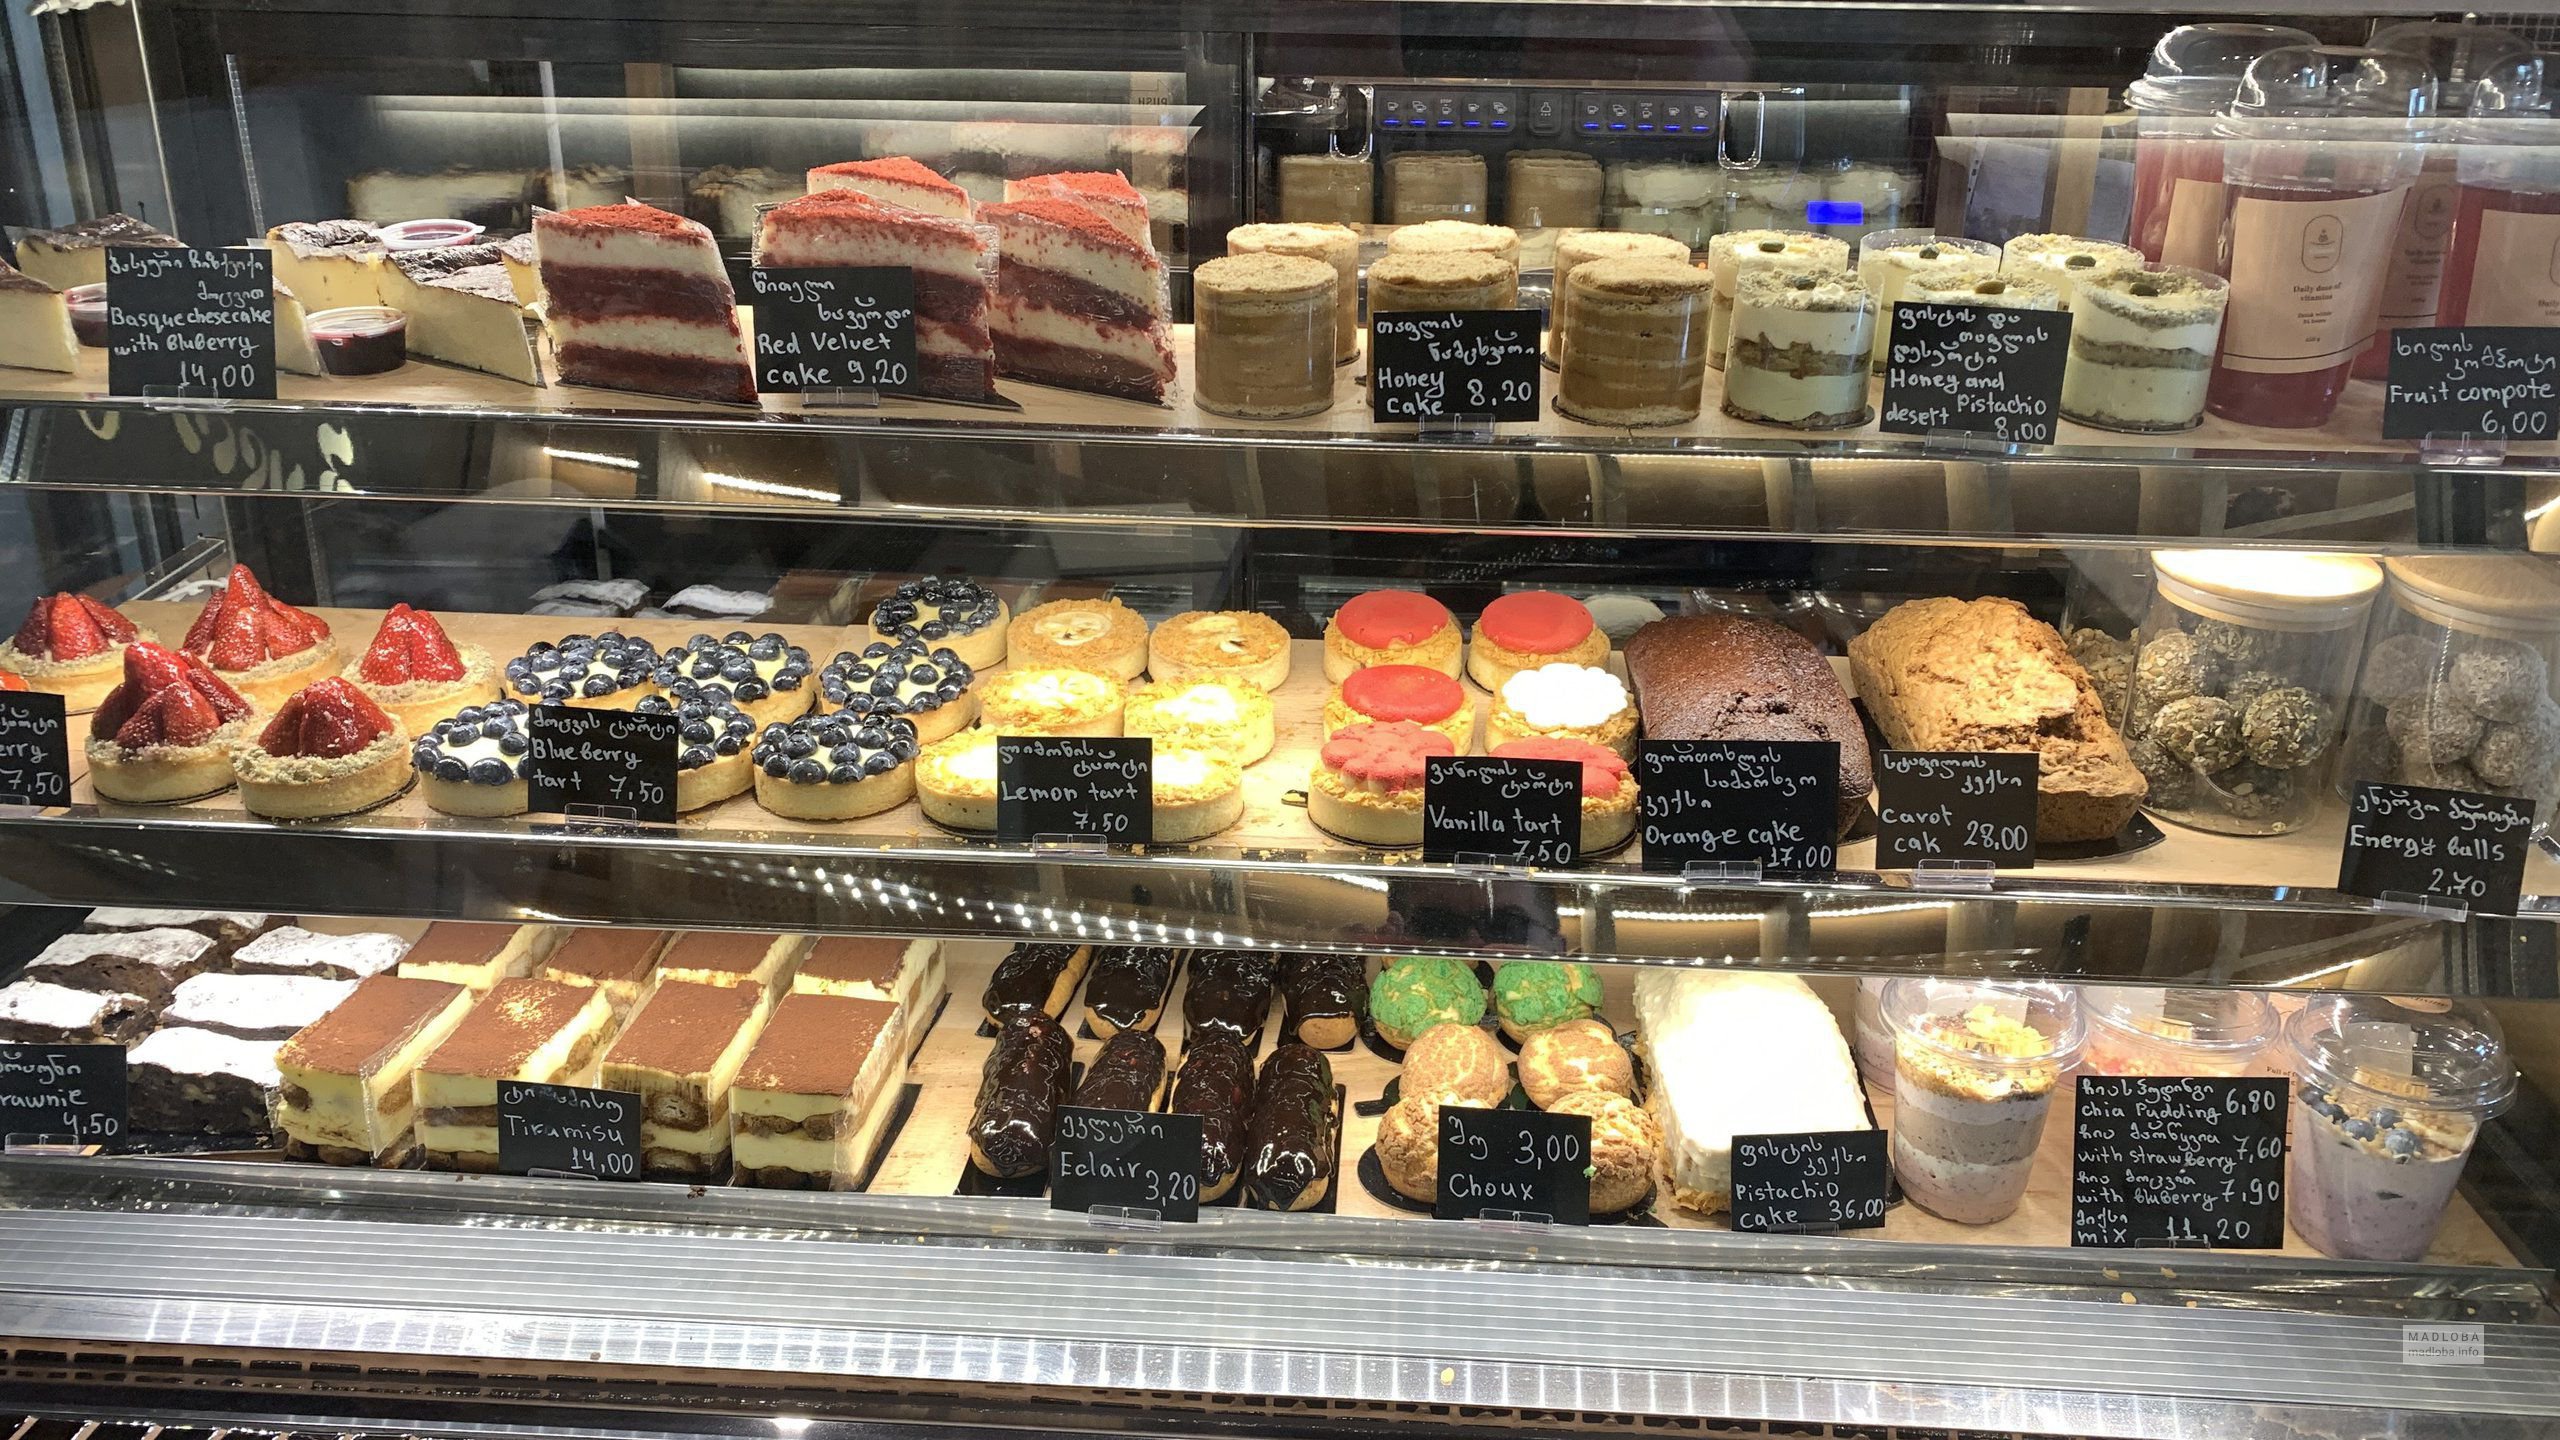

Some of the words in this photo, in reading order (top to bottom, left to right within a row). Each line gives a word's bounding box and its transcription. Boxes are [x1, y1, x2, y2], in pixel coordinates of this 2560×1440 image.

[113, 332, 159, 356] with
[757, 331, 802, 355] Red
[810, 332, 892, 351] Velvet
[179, 360, 255, 390] 14,00
[1377, 366, 1445, 399] Honey
[1889, 367, 1960, 395] Honey
[1965, 371, 2006, 392] and
[1957, 391, 2047, 416] Pistachio
[2389, 381, 2450, 404] Fruit
[2456, 378, 2556, 408] compote
[1885, 401, 1950, 426] desert
[2481, 409, 2548, 434] 6,00
[533, 767, 582, 791] tart
[608, 774, 665, 804] 7,50
[1001, 780, 1079, 803] Lemon
[1088, 781, 1139, 802] tart
[1072, 810, 1129, 832] 7,50
[1428, 804, 1506, 833] Vanilla
[1512, 807, 1563, 836] tart
[1645, 824, 1742, 853] Orange
[1747, 820, 1806, 846] cake
[2350, 824, 2437, 859] Energy
[1766, 845, 1832, 869] 17,00
[2427, 867, 2487, 898] 2,70
[2225, 1087, 2277, 1116] 6,80
[62, 1111, 119, 1136] 4,50
[571, 1146, 634, 1175] 14,00
[1514, 1130, 1580, 1171] 3,00
[2078, 1145, 2123, 1165] with
[2232, 1134, 2282, 1164] 7,60
[1060, 1151, 1142, 1179] Eclair
[1145, 1169, 1197, 1207] 3,20
[1448, 1173, 1535, 1201] Choux
[1735, 1179, 1840, 1202] Pistachio
[2219, 1177, 2281, 1205] 7,90
[2077, 1186, 2124, 1204] with
[1739, 1206, 1799, 1229] cake
[1828, 1198, 1885, 1222] 36,00
[2166, 1215, 2251, 1245] 11,20
